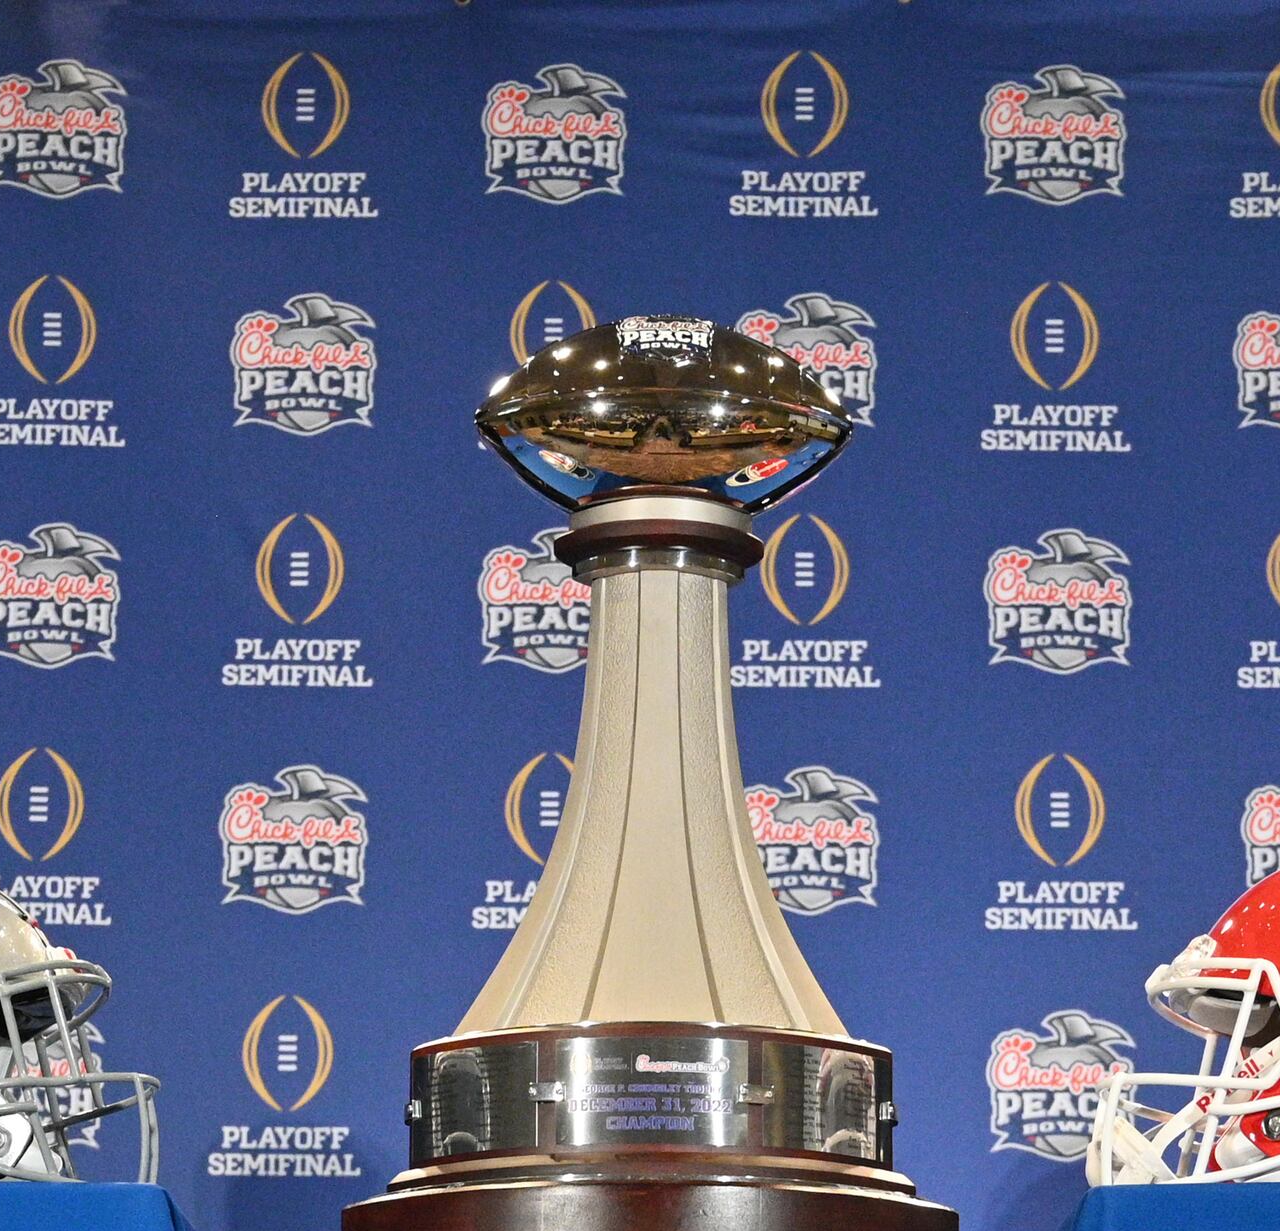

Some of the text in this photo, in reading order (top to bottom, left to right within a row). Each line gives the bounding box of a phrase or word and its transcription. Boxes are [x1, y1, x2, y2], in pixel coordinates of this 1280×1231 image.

[491, 140, 618, 171] PEACH
[990, 141, 1118, 172] PEACH
[18, 160, 92, 175] BOWL
[517, 167, 592, 179] BOWL
[1017, 168, 1092, 180] BOWL
[241, 171, 367, 194] PLAYOFF
[741, 170, 866, 192] PLAYOFF
[229, 195, 379, 219] SEMIFINAL
[729, 194, 878, 218] SEMIFINAL
[622, 330, 708, 347] PEACH
[640, 342, 692, 351] BOWL
[240, 371, 368, 402] PEACH
[266, 398, 342, 410] BOWL
[993, 404, 1118, 426] PLAYOFF
[981, 429, 1131, 452] SEMIFINAL
[994, 608, 1124, 640] PEACH
[8, 630, 85, 643] BOWL
[1021, 635, 1098, 648] BOWL
[235, 638, 361, 661] PLAYOFF
[743, 639, 867, 662] PLAYOFF
[222, 664, 373, 687] SEMIFINAL
[731, 664, 880, 689] SEMIFINAL
[228, 846, 359, 879] PEACH
[255, 874, 332, 887] BOWL
[998, 880, 1124, 904] PLAYOFF
[985, 906, 1138, 931] SEMIFINAL
[690, 1098, 733, 1113] 2022
[606, 1116, 696, 1131] CHAMPION
[221, 1125, 349, 1149] PLAYOFF
[207, 1152, 362, 1177] SEMIFINAL
